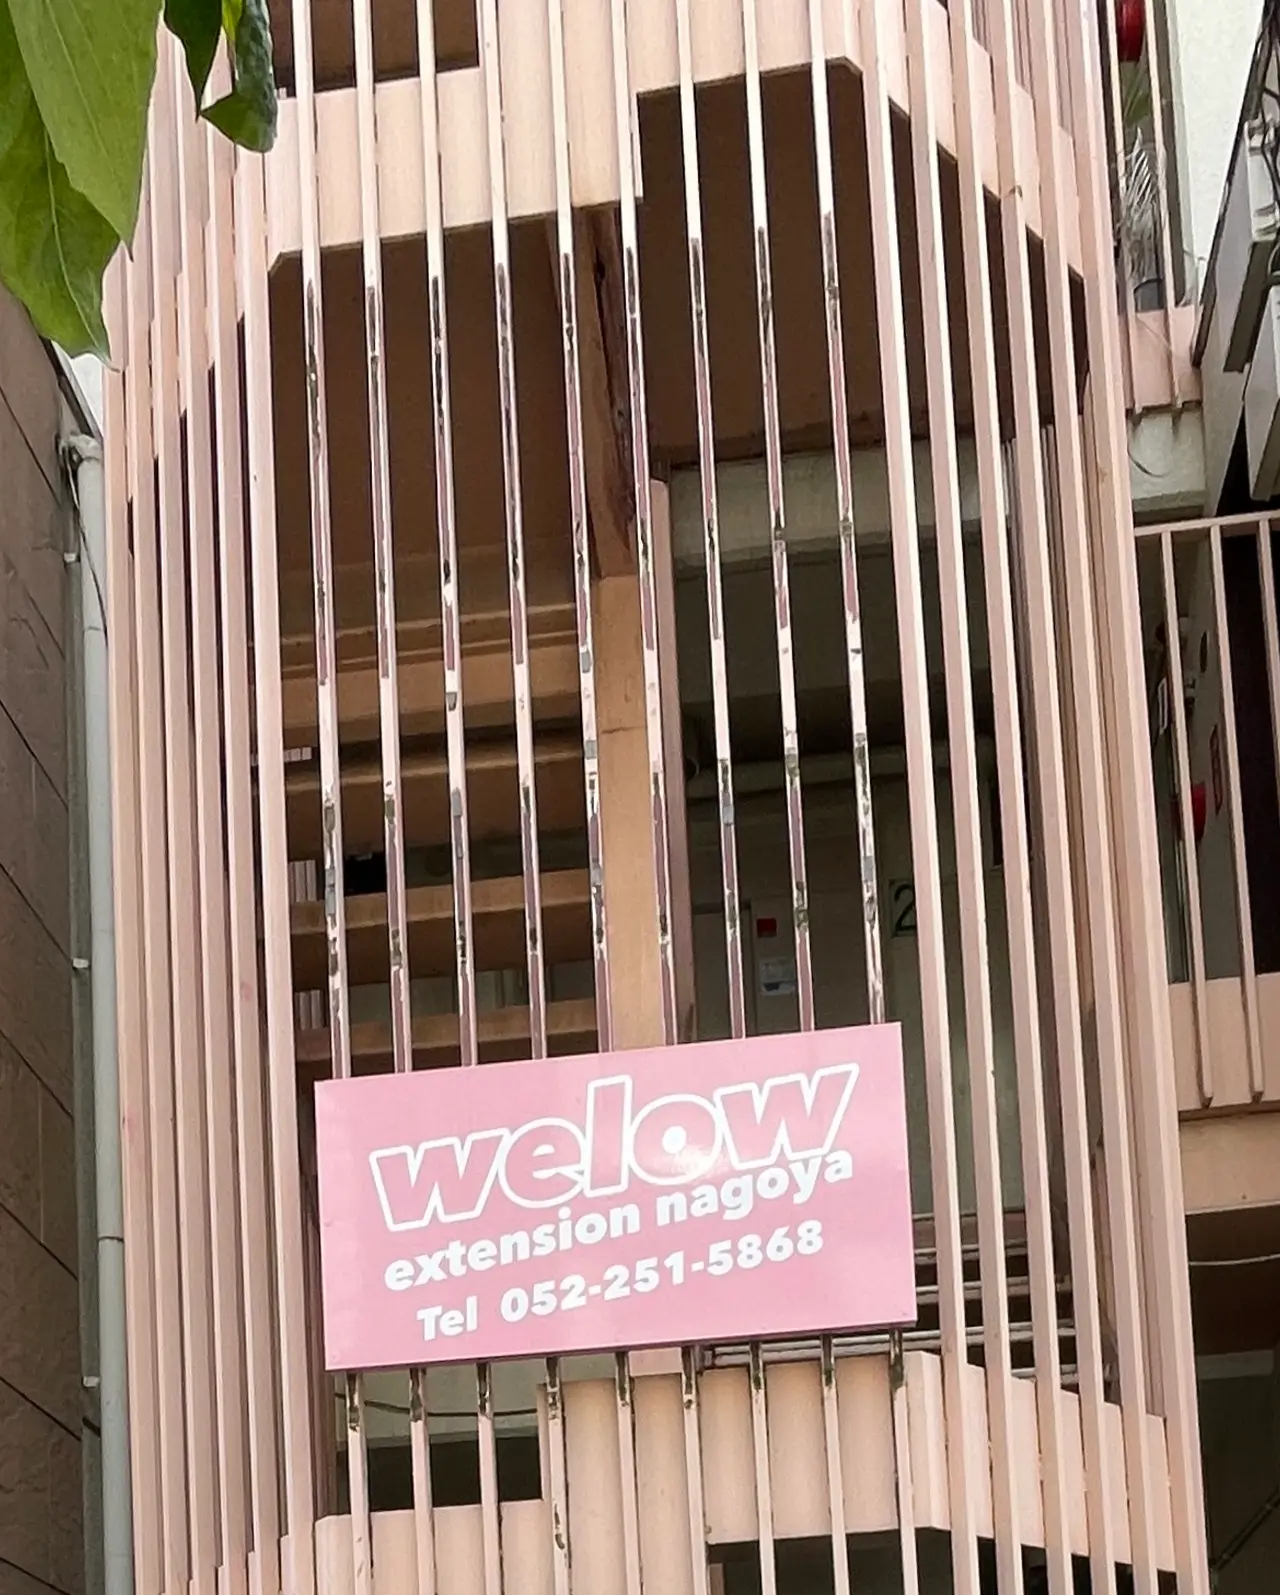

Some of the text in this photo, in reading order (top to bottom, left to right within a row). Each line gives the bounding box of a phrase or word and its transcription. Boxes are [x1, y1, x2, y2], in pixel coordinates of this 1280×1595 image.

[369, 1062, 860, 1233] welow
[384, 1146, 854, 1292] extension nagoya
[417, 1221, 825, 1342] Tel 052-251-5868
